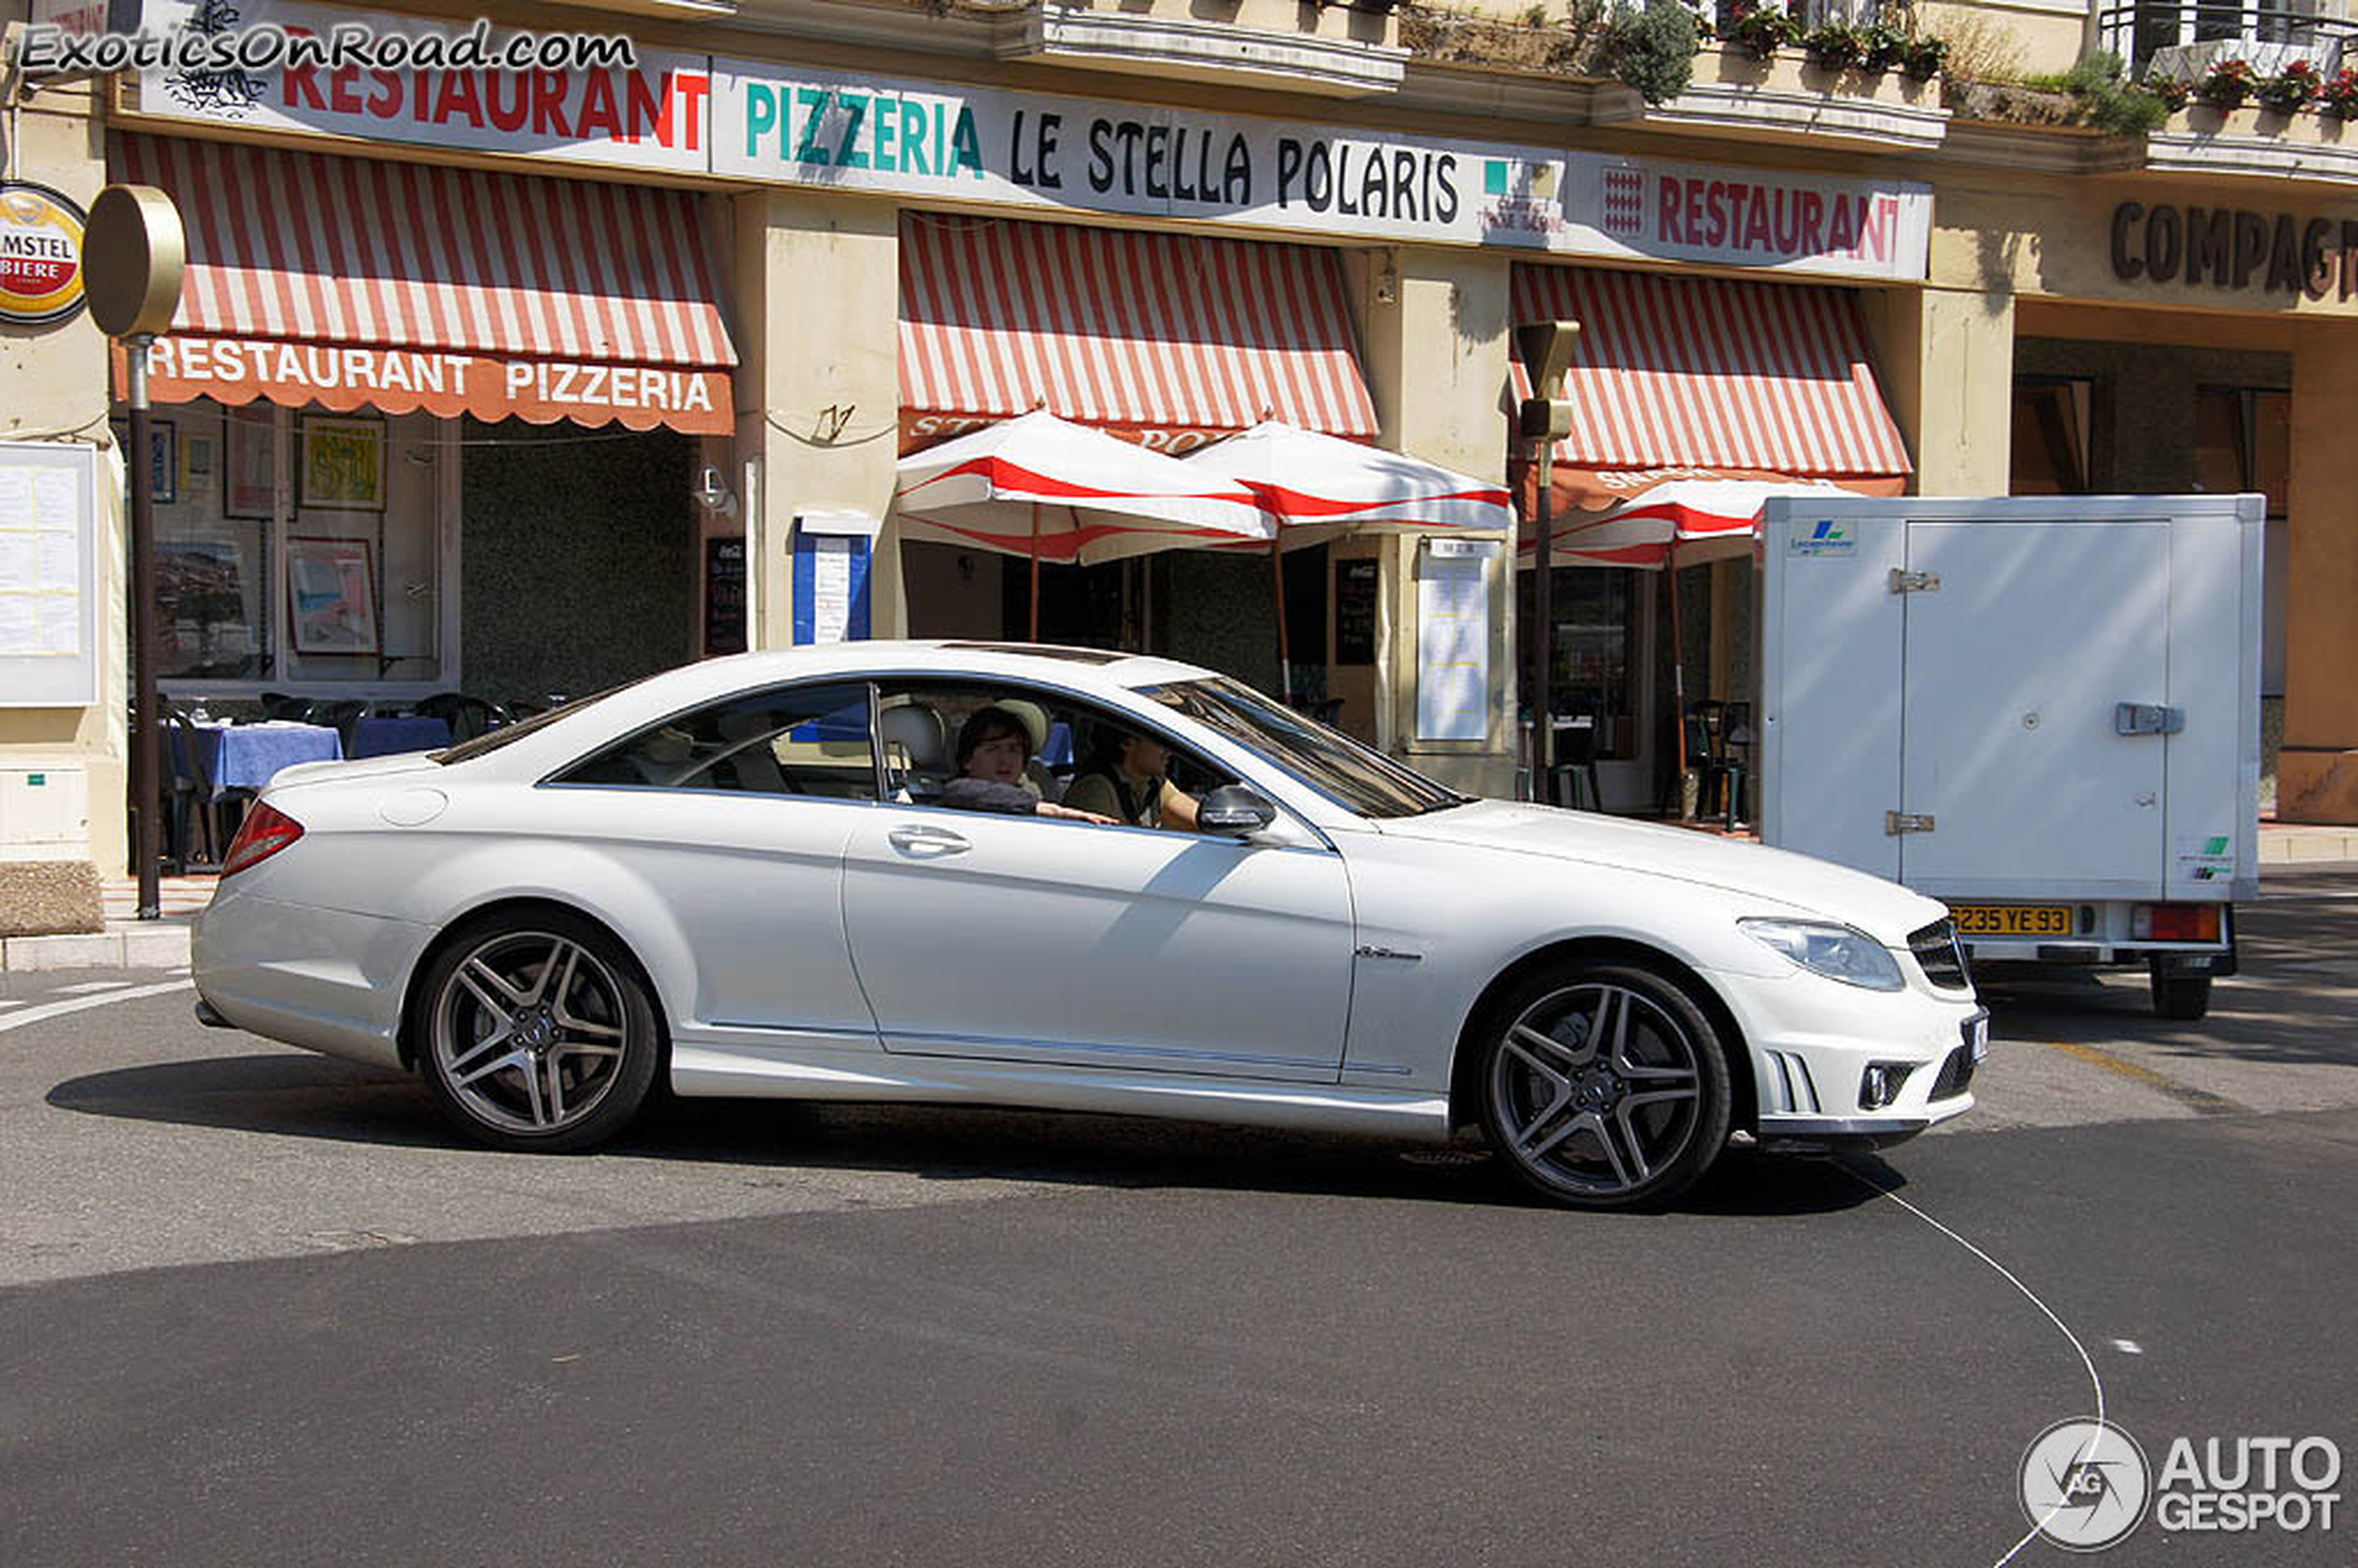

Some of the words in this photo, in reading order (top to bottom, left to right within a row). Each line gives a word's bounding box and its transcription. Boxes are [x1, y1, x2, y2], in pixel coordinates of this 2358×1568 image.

[746, 83, 984, 180] PIZZERIA
[1010, 110, 1063, 189] LE
[1088, 119, 1251, 205] STELLA
[1277, 138, 1458, 224] POLARIS
[3, 235, 72, 259] MSTEL
[2, 260, 59, 279] BIERE
[147, 337, 473, 395] RESTAURANT
[506, 360, 713, 411] PIZZERIA
[2006, 909, 2033, 931] YE
[2037, 909, 2065, 931] 93
